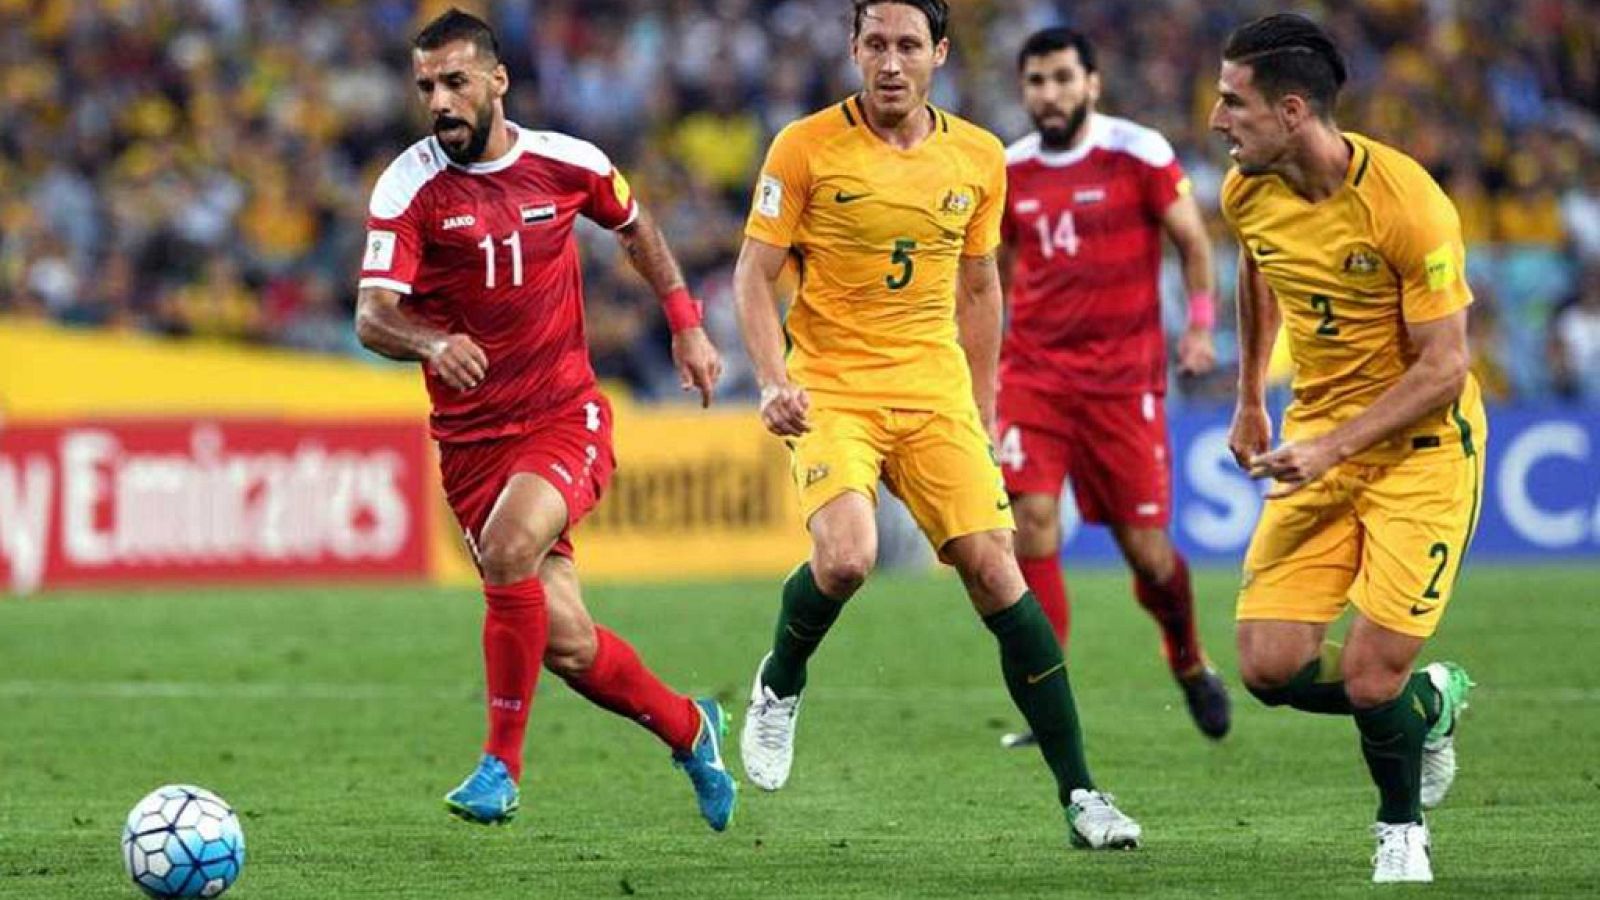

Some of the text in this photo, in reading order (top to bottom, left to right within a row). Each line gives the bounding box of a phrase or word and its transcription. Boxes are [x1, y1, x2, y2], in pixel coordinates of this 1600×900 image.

[442, 214, 475, 230] JAKO
[1036, 211, 1080, 258] 14
[478, 230, 523, 288] 11
[886, 239, 916, 290] 5
[1311, 294, 1340, 337] 2
[62, 426, 408, 565] Emirates
[1423, 542, 1448, 600] 2
